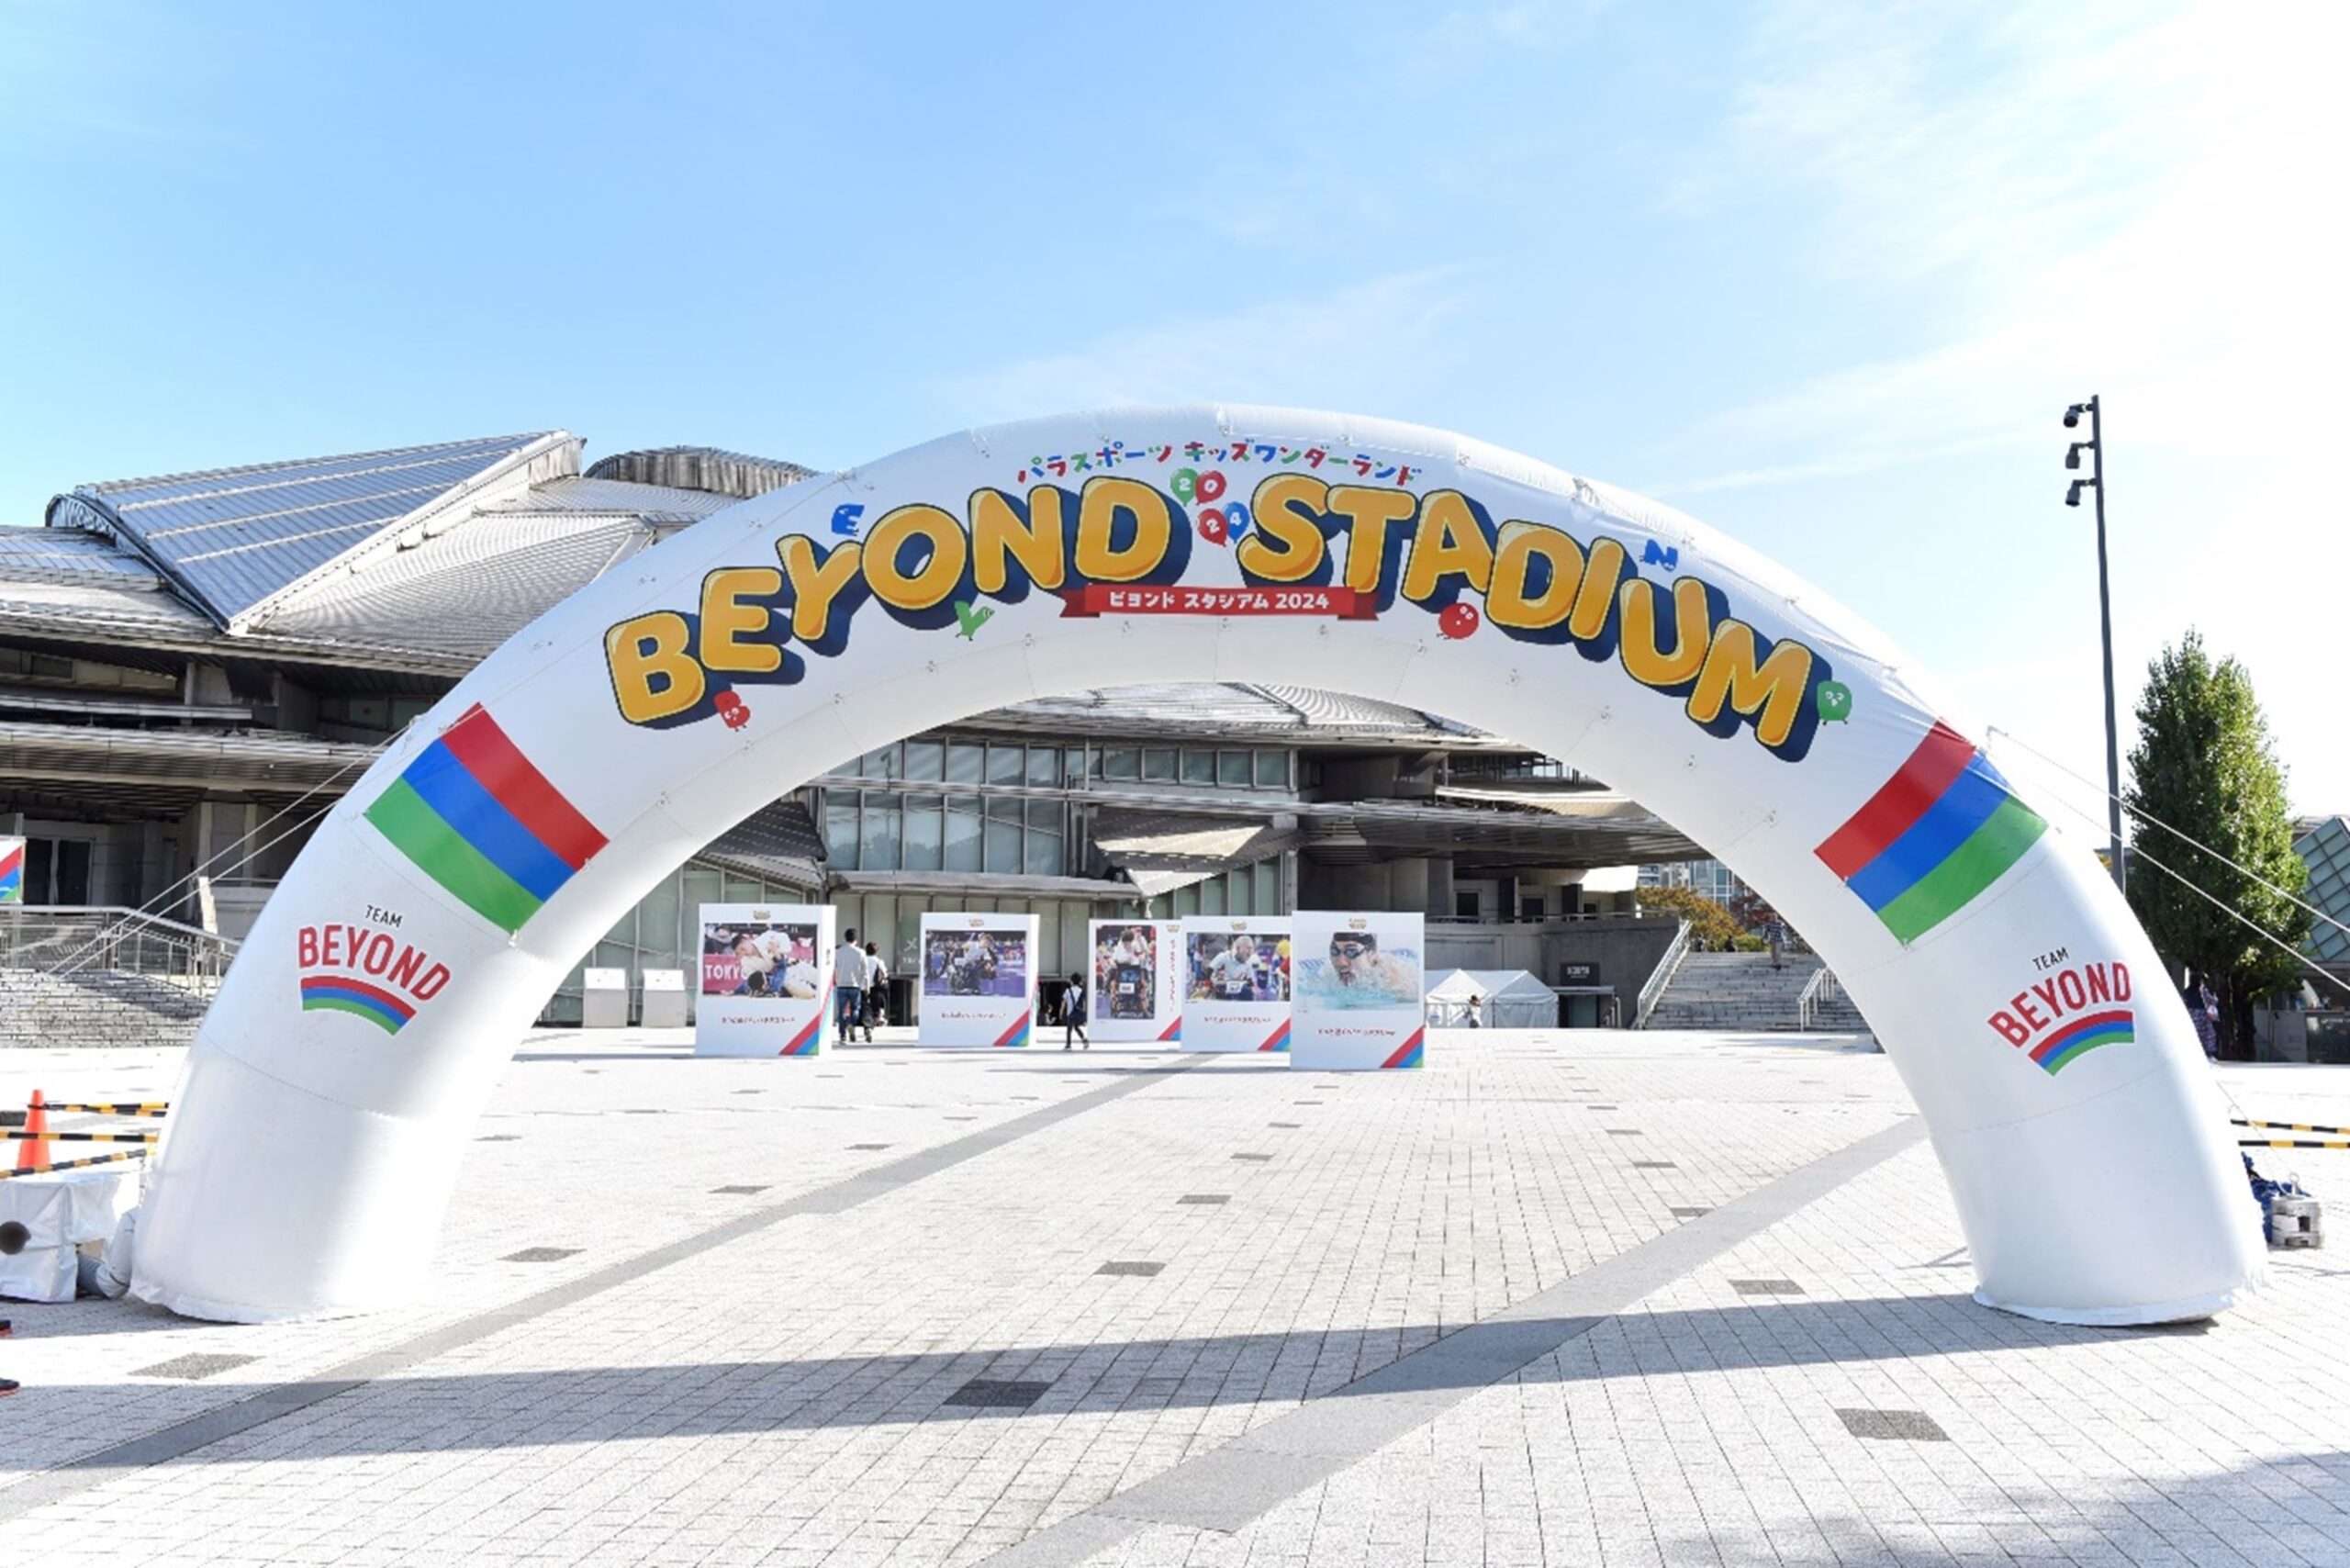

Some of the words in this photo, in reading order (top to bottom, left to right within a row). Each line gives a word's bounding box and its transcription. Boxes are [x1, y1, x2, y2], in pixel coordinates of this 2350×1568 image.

[1018, 441, 1172, 483] パラスポーツ
[1184, 438, 1422, 487] キッズワンダーランド
[603, 474, 1192, 730] BEYOND
[1236, 471, 1833, 763] STADIUM
[1109, 590, 1175, 609] ビヨンド
[1184, 592, 1270, 610] スタジアム
[1275, 592, 1330, 610] 2024
[364, 904, 403, 928] TEAM
[298, 924, 452, 1002] BEYOND
[2031, 946, 2070, 971] TEAM
[1986, 960, 2132, 1049] BEYOND
